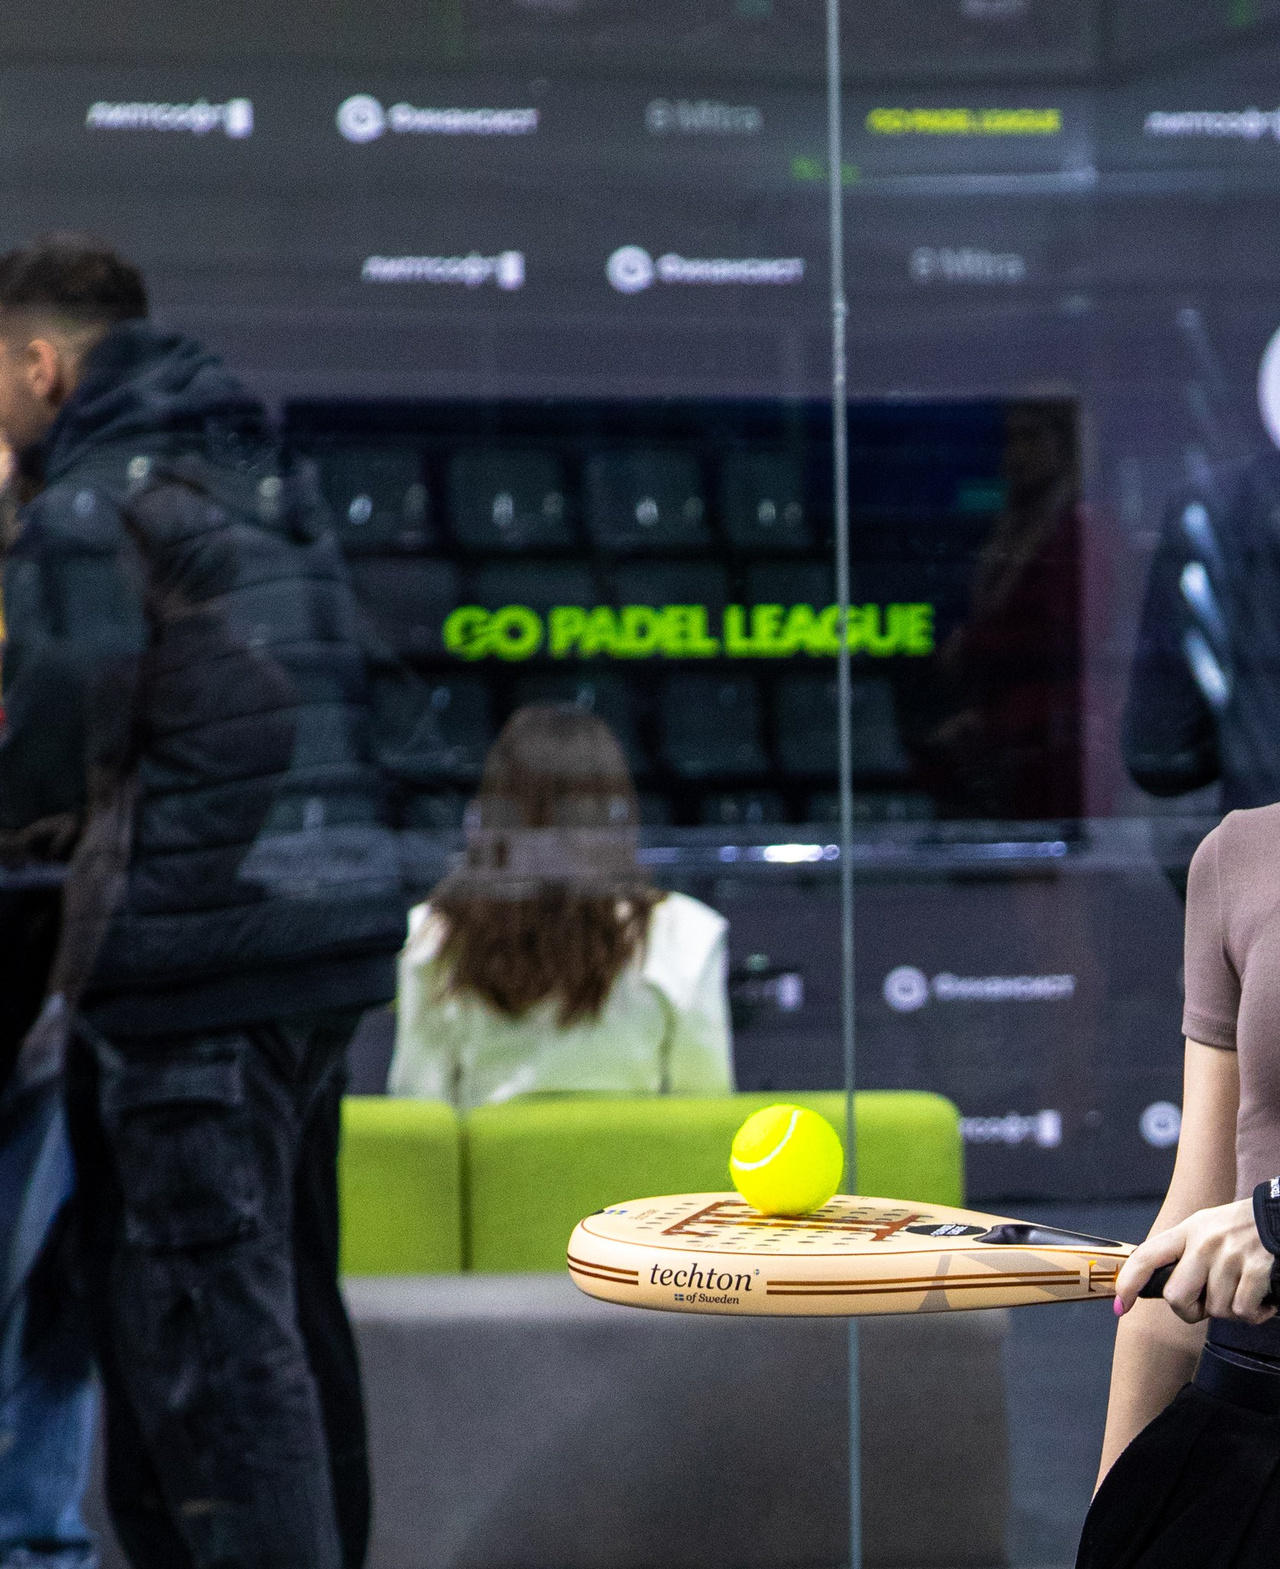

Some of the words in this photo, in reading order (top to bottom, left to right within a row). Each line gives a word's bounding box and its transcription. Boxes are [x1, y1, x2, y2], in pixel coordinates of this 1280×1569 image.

[443, 604, 543, 659] GO
[549, 604, 719, 658] PADEL
[723, 602, 934, 657] LEAGUE
[650, 1263, 752, 1292] techton
[686, 1292, 698, 1304] of
[698, 1293, 740, 1304] Sweden
